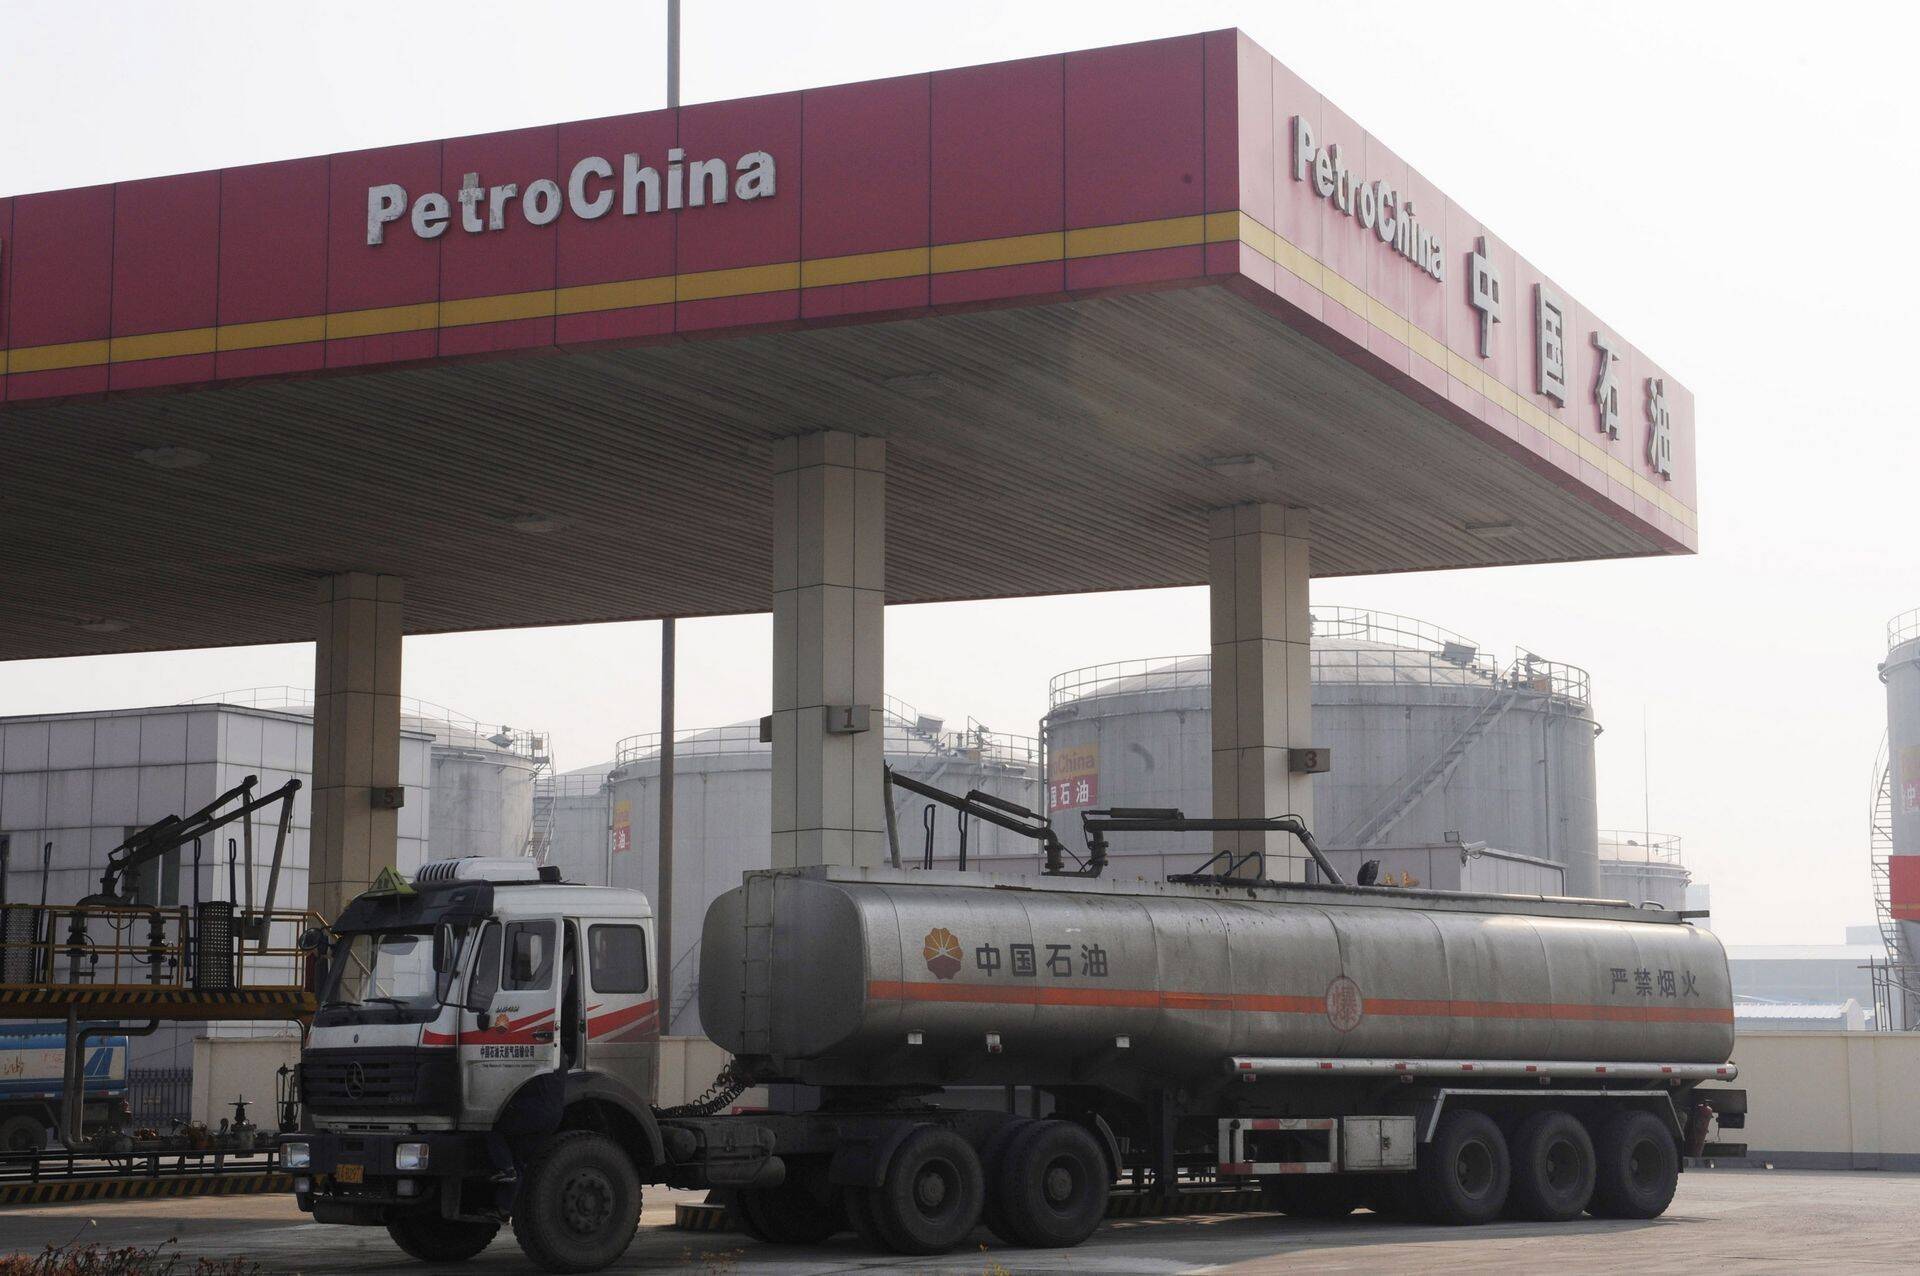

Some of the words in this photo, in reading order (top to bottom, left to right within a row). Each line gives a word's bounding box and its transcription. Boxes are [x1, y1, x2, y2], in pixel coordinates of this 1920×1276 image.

[366, 148, 777, 246] PetroChina
[1293, 115, 1443, 282] PetroChina
[1468, 236, 1672, 482] 中国石油
[843, 708, 855, 729] 1
[1304, 750, 1318, 769] 3
[976, 942, 1108, 978] 中国石油
[1609, 967, 1700, 998] 严禁烟火
